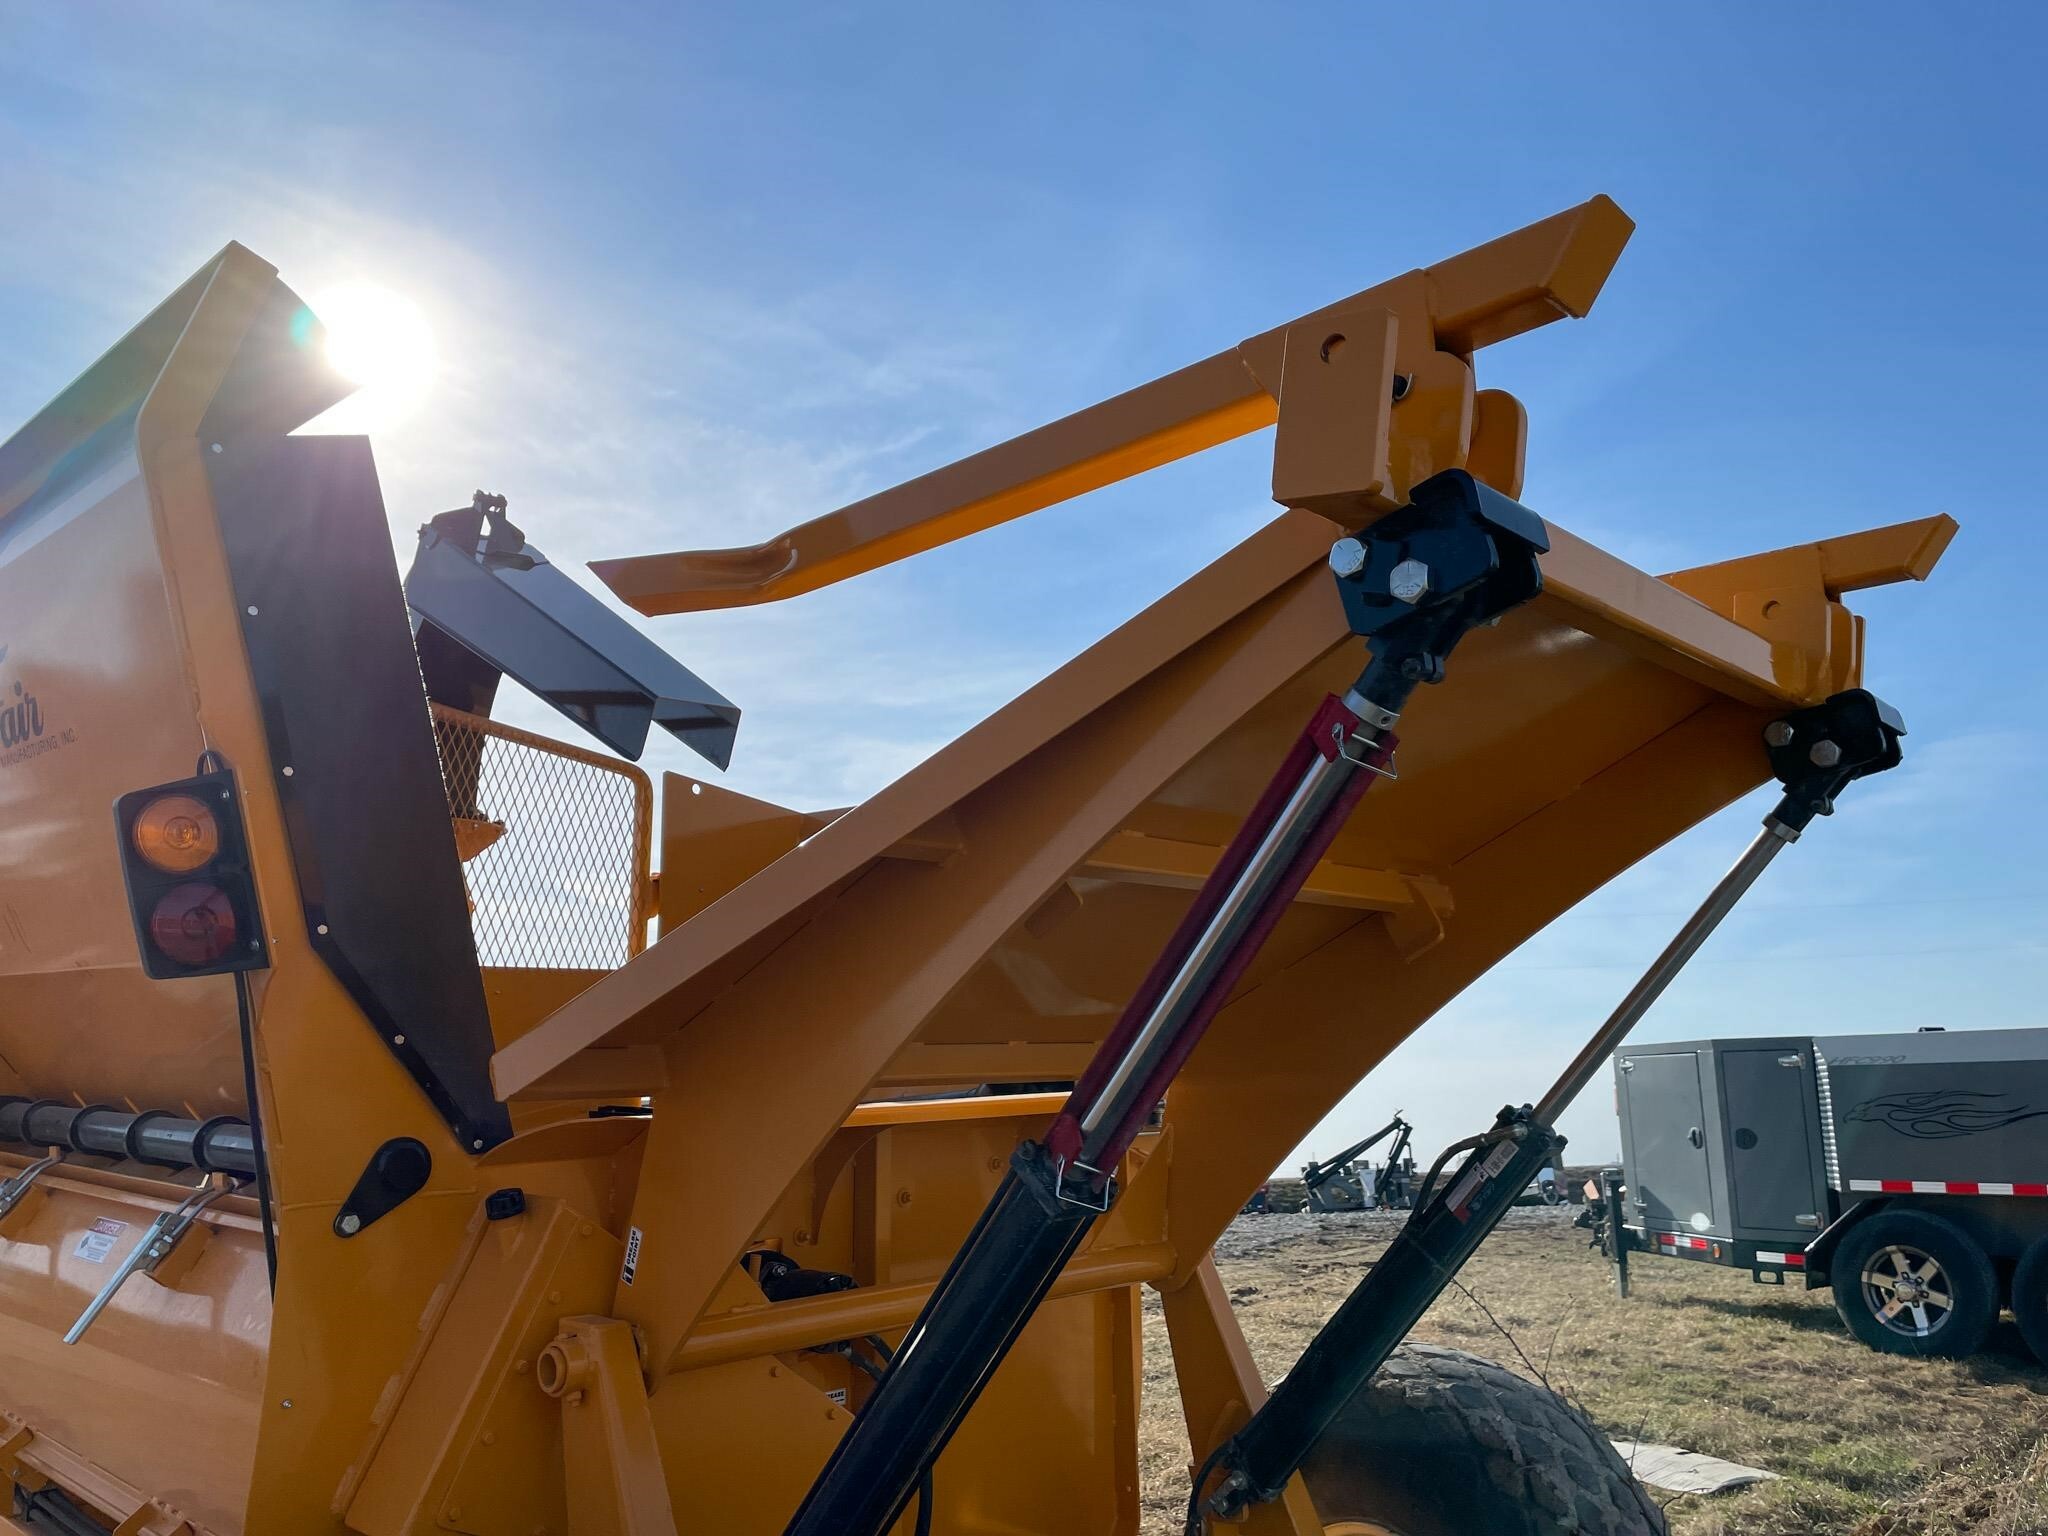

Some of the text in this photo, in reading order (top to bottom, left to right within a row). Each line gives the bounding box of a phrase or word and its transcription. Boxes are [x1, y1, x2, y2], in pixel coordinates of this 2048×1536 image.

[0, 679, 44, 748] air
[626, 1229, 637, 1265] GREASE
[631, 1236, 640, 1264] POINT
